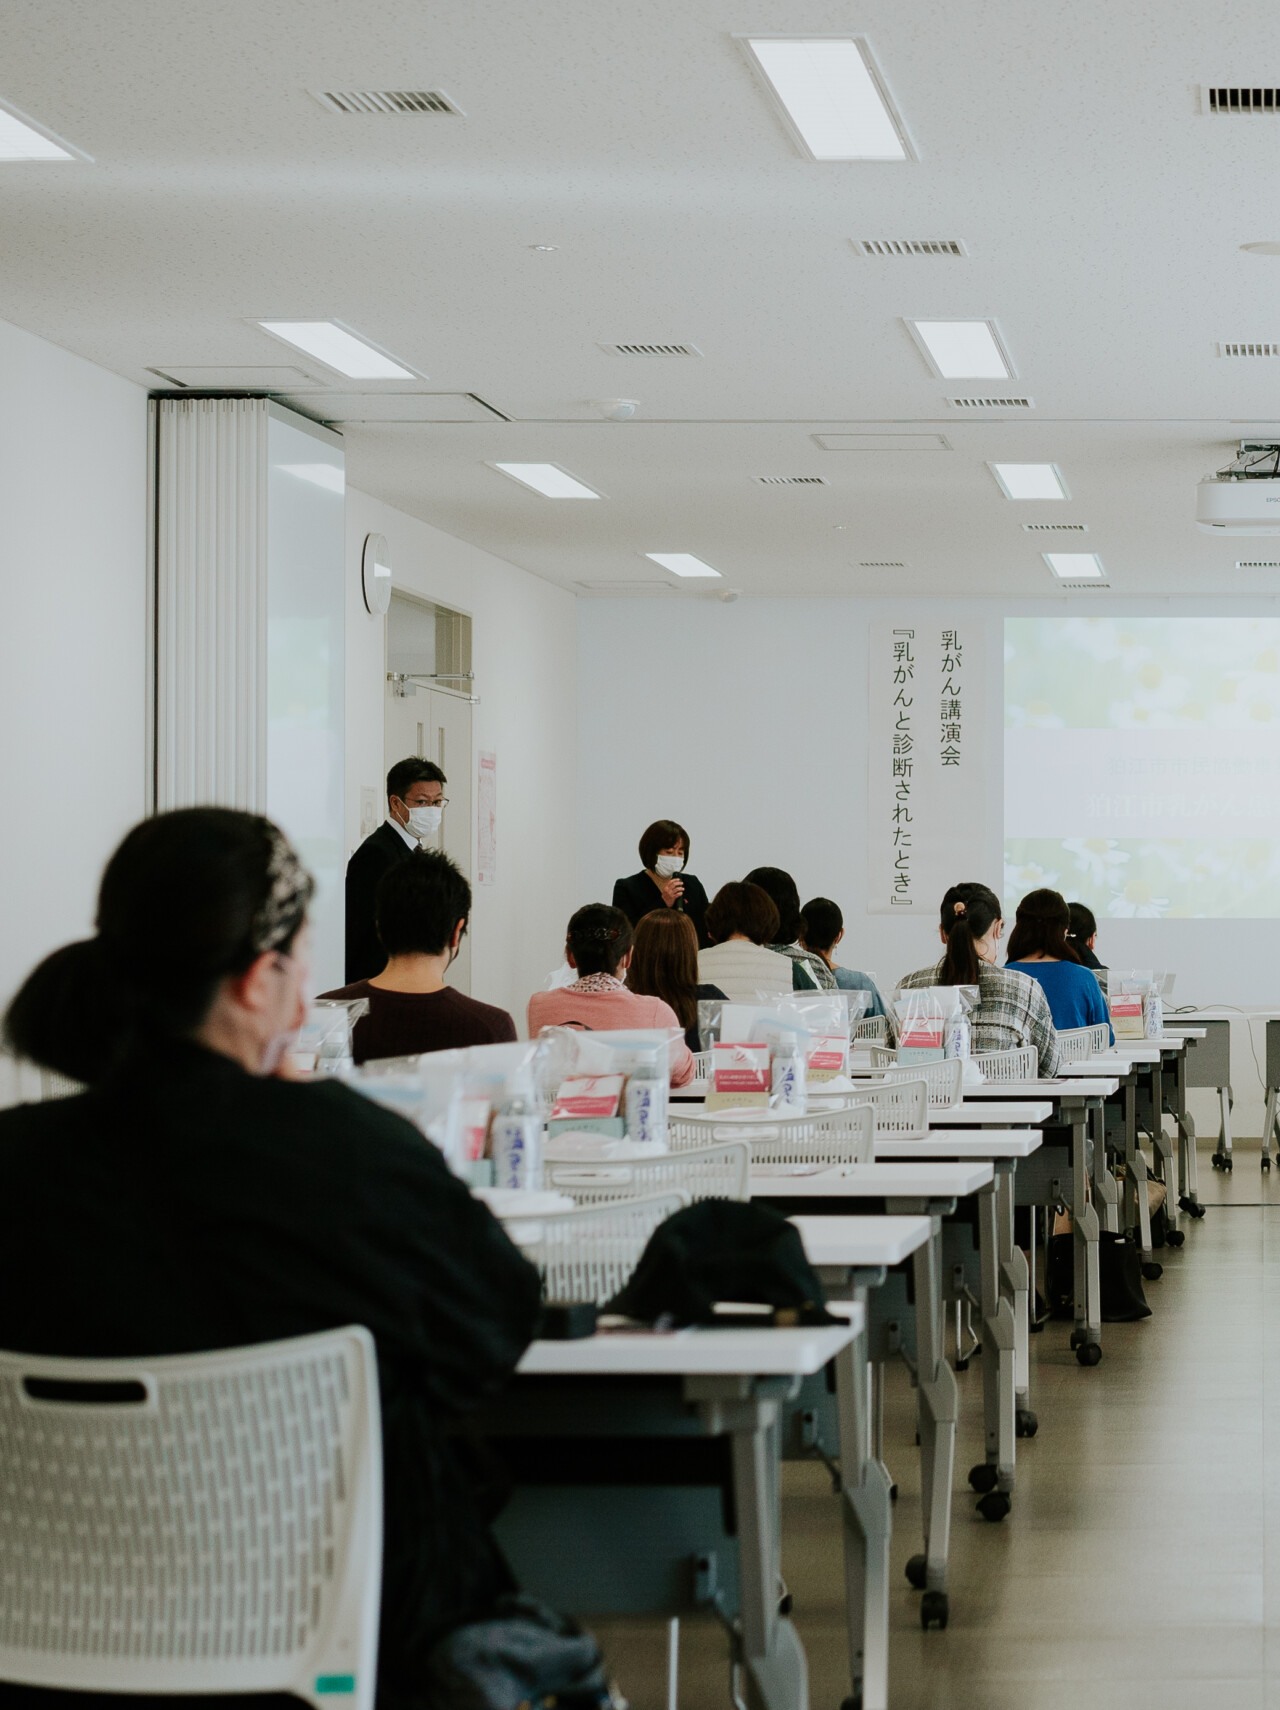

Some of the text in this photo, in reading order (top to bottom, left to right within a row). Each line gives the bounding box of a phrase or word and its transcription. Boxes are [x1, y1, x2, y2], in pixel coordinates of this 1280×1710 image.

[890, 629, 915, 906] 『乳がんと診断されたとき』
[940, 629, 963, 767] 乳がん講演会
